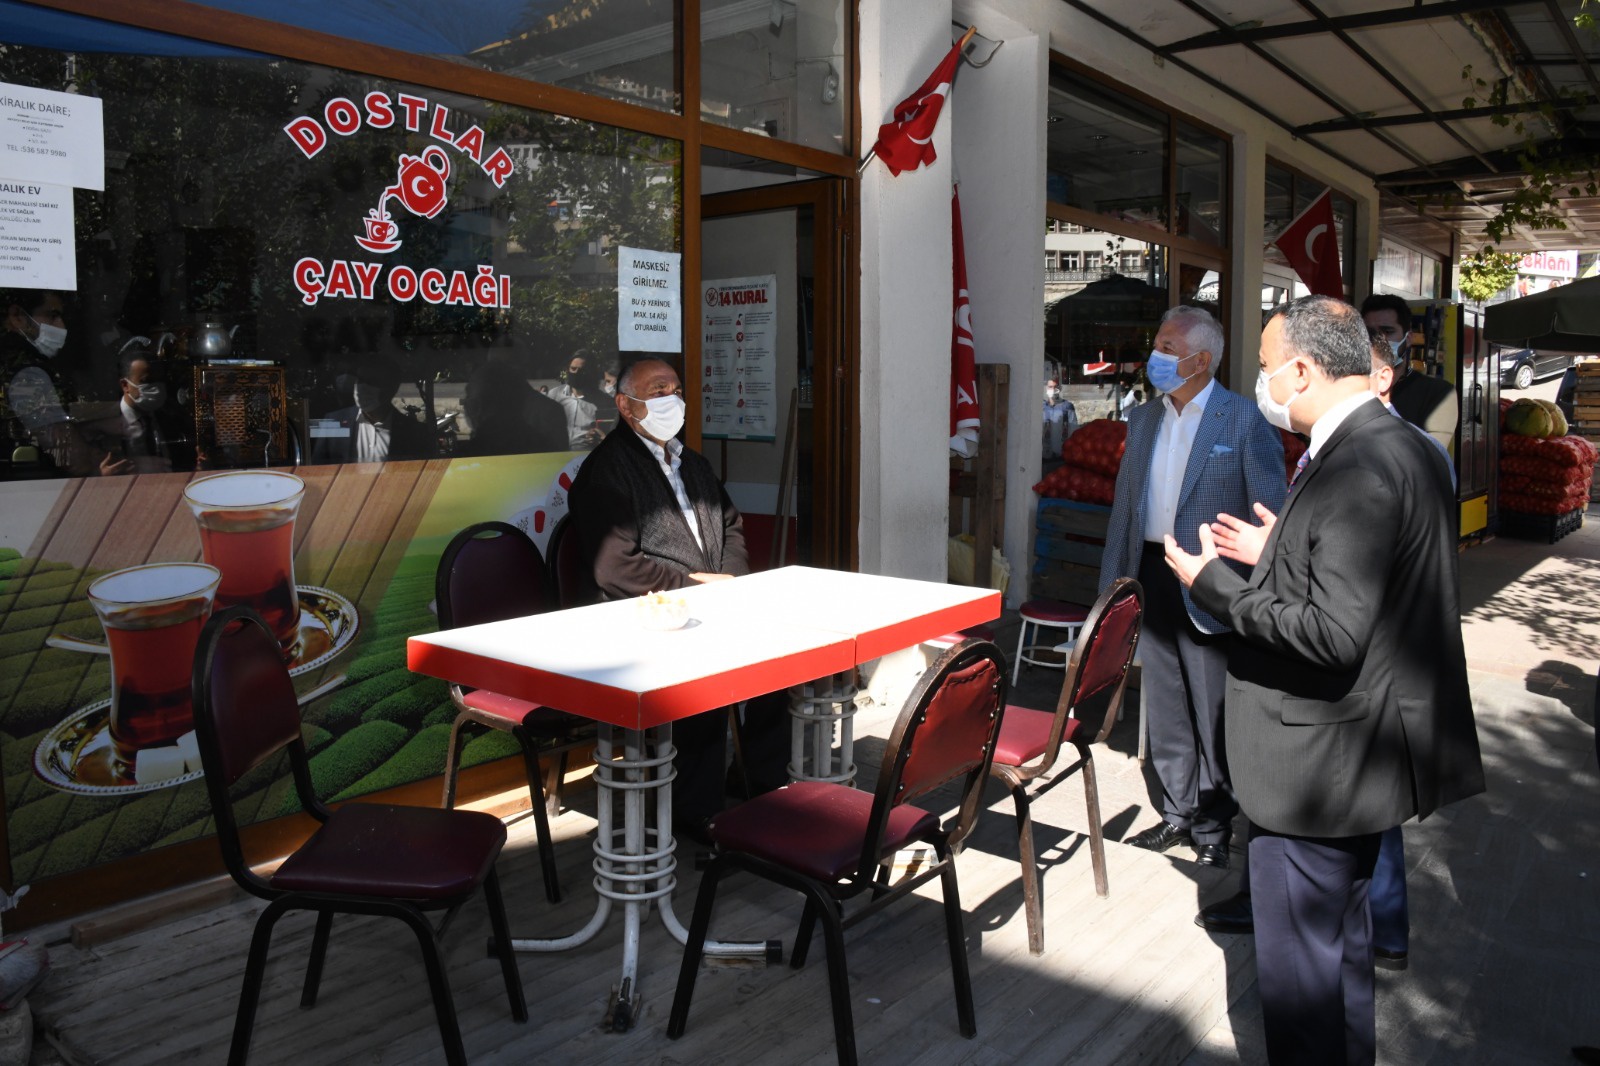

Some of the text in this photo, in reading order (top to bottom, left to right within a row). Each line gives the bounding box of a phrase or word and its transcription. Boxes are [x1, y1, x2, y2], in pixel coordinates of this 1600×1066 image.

[38, 103, 71, 117] DAİRE;
[283, 91, 514, 189] DOSTLAR
[28, 185, 41, 195] EV
[632, 259, 670, 272] MASKESİZ
[293, 256, 511, 309] ÇAY OCAĞI
[632, 275, 669, 289] GİRİLMEZ.
[631, 297, 640, 306] BU
[647, 298, 671, 308] YERİNDE
[719, 289, 768, 307] 14 KURAL
